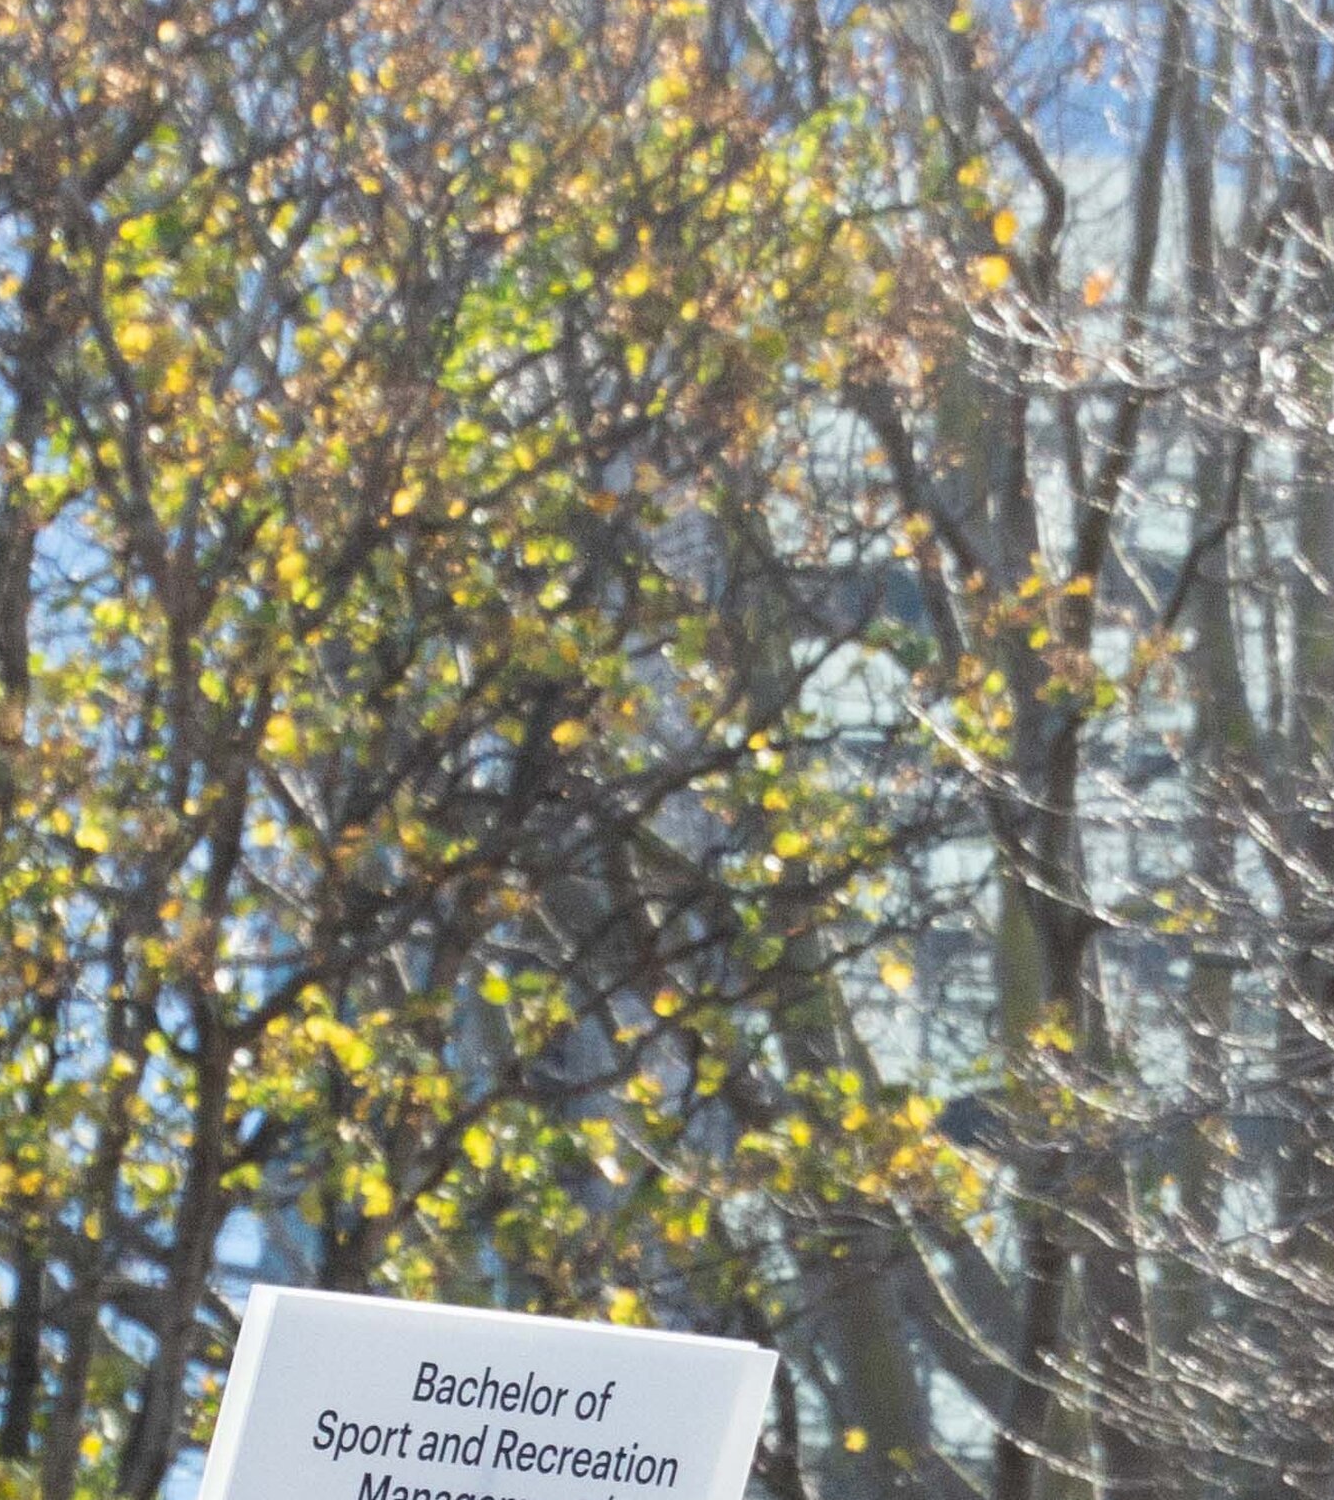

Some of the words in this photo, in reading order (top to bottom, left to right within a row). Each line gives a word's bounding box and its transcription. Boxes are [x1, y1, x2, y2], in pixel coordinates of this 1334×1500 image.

[412, 1361, 570, 1417] Bachelor
[575, 1380, 617, 1422] of
[312, 1409, 414, 1462] Sport
[417, 1424, 490, 1467] and
[491, 1429, 679, 1489] Recreation
